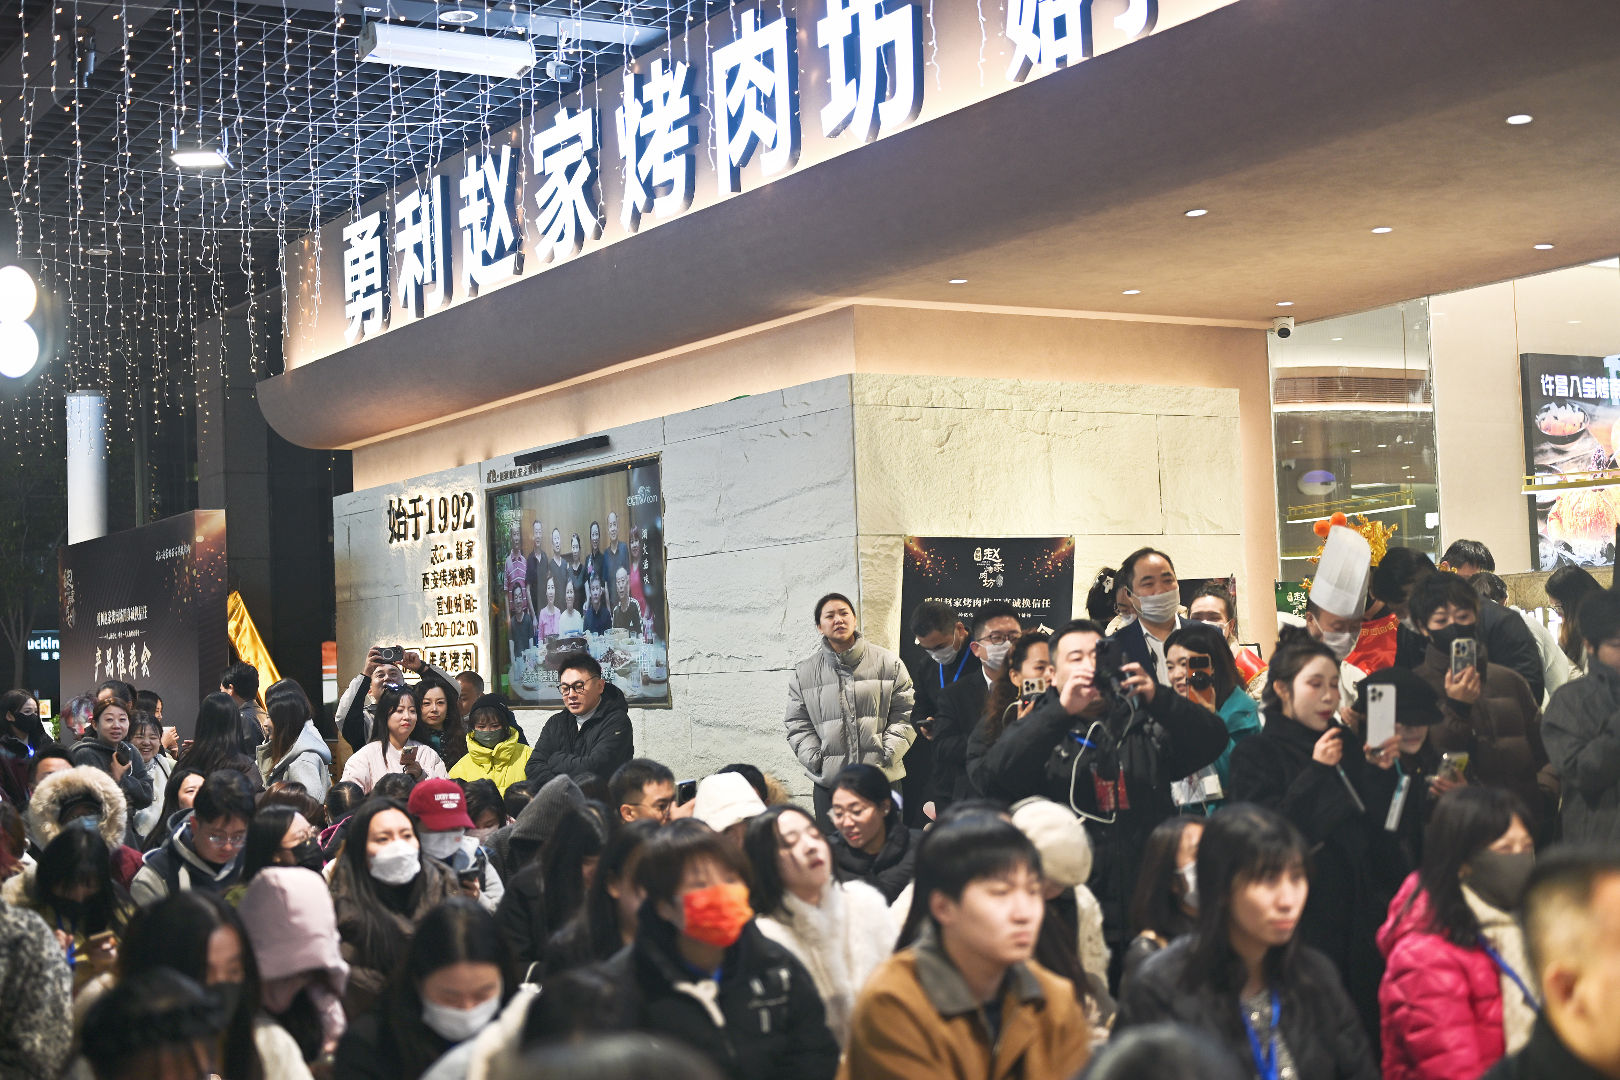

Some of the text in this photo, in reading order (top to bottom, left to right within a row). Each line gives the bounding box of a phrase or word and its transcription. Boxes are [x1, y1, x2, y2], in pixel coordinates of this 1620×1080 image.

[341, 0, 924, 343] 勇利赵家烤肉坊
[387, 491, 475, 545] 始于1992
